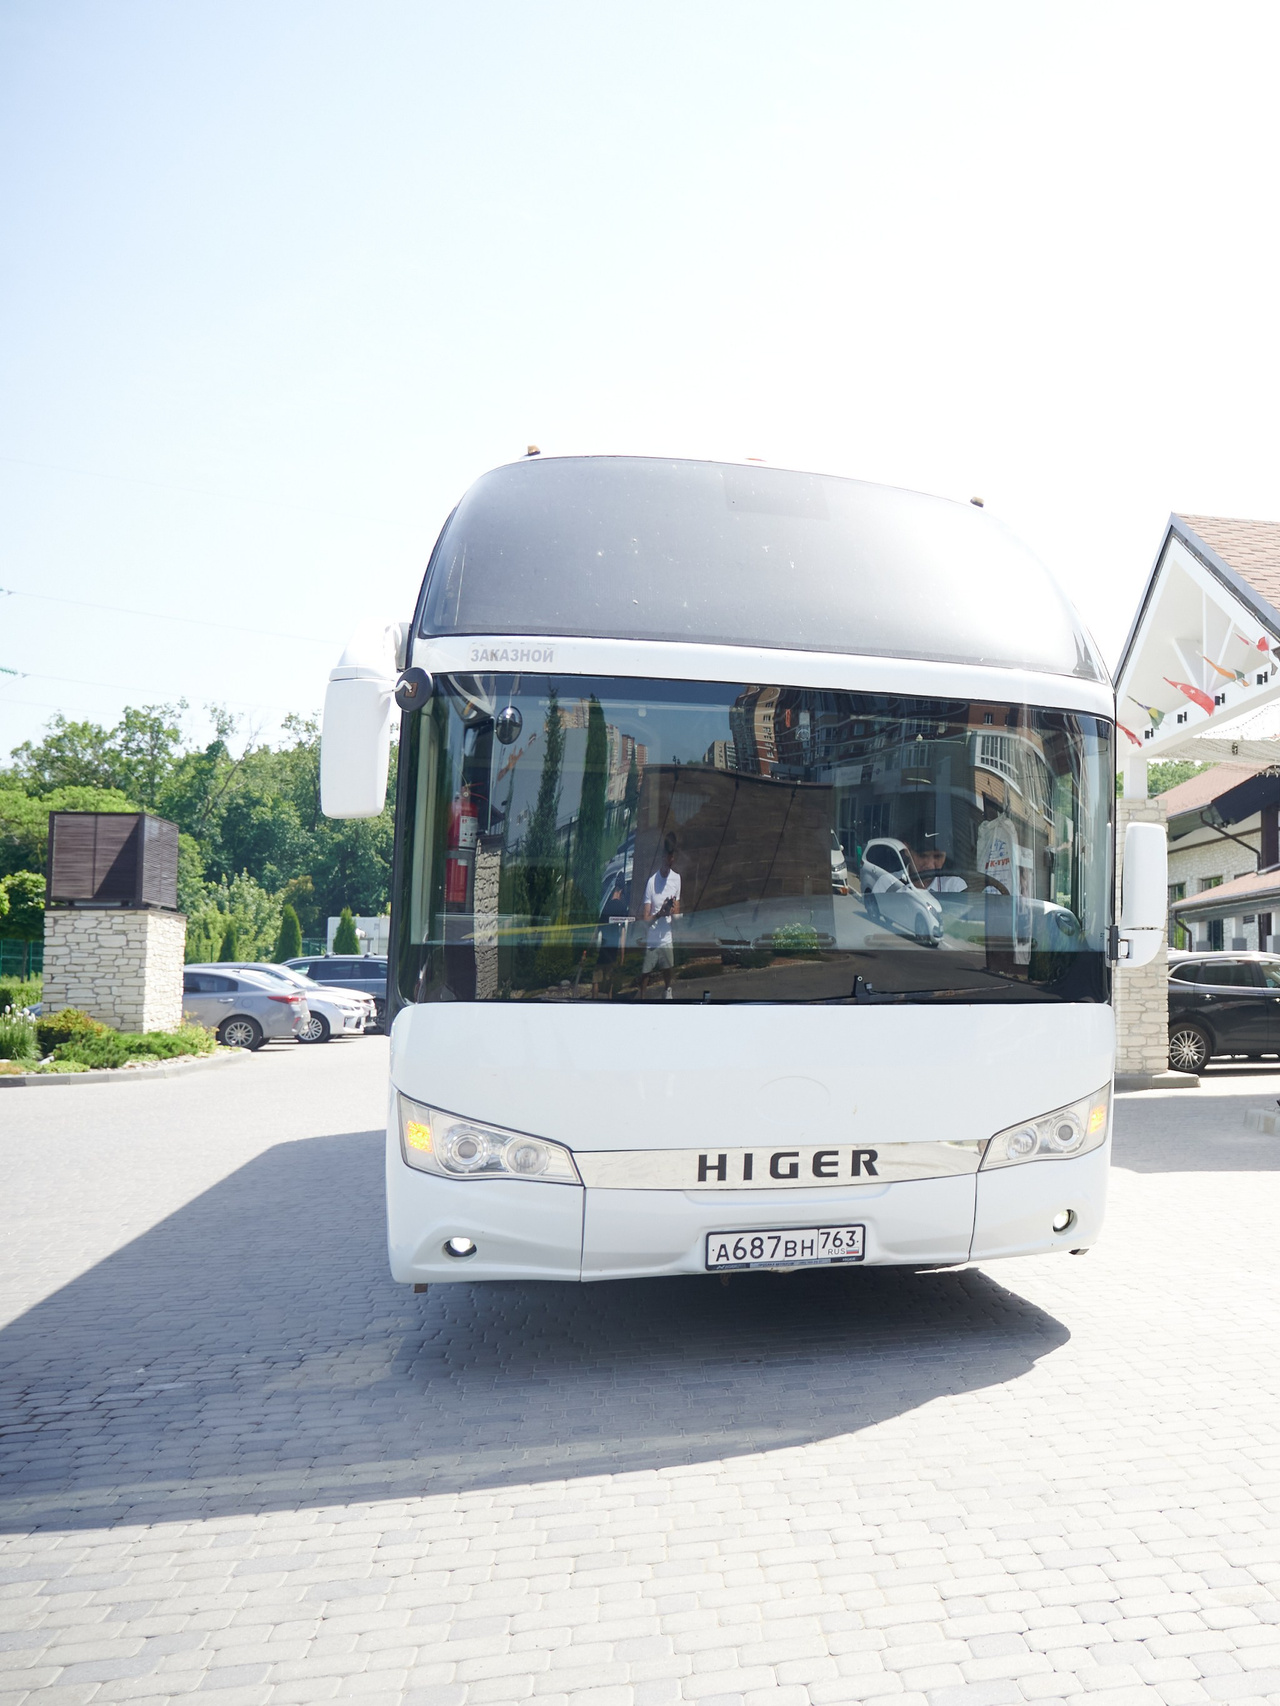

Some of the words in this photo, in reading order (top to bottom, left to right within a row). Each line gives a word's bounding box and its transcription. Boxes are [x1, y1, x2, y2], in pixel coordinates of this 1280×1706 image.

[470, 647, 554, 663] ЗАКАЗНОЙ
[697, 1149, 879, 1182] HIGER
[716, 1235, 814, 1262] А687ВН
[820, 1230, 856, 1249] 763
